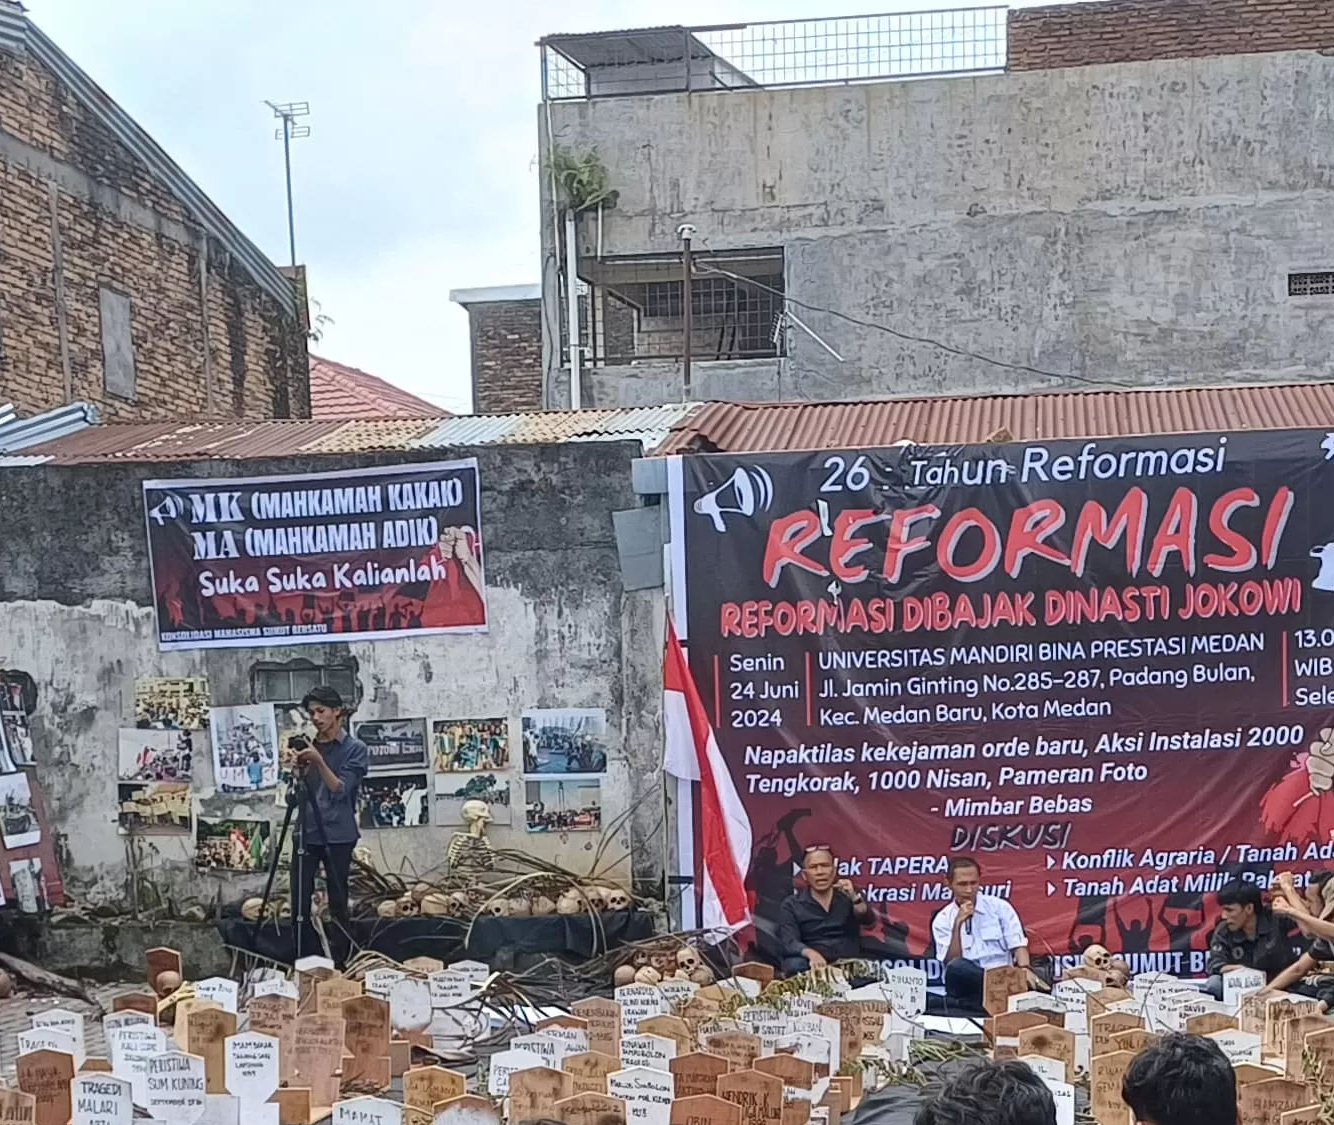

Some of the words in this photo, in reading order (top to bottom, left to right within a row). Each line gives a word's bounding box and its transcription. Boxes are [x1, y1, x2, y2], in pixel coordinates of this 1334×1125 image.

[819, 456, 870, 493] 26
[911, 457, 1006, 487] Tahun
[1021, 437, 1227, 483] Reformasi
[189, 491, 245, 524] MK
[251, 487, 382, 520] (MAHKAMAH
[387, 478, 463, 511] KAKAK)
[192, 529, 241, 560] MA
[245, 524, 376, 558] (MAHKAMAH
[382, 516, 438, 548] ADIK)
[763, 486, 1295, 588] REFORMASI
[199, 571, 259, 598] Suka
[266, 568, 326, 593] Suka
[334, 554, 447, 588] Kalianlah
[721, 597, 895, 638] REFORMASI
[903, 590, 1037, 633] DIBAJAK
[1045, 586, 1170, 626] DINASTI
[1178, 578, 1302, 620] JOKOWI
[730, 654, 784, 672] Senin
[819, 647, 945, 670] UNIVERSITAS
[950, 643, 1034, 665] MANDIRI
[1039, 640, 1086, 662] BINA
[1091, 637, 1186, 660] PRESTASI
[1191, 633, 1265, 654] MEDAN
[1295, 657, 1333, 675] WIB
[730, 684, 756, 700] 24
[759, 681, 799, 700] Juni
[819, 677, 838, 698] Jl.
[842, 677, 903, 698] Jamin
[907, 674, 978, 699] Ginting
[1109, 667, 1187, 688] Padang
[1193, 664, 1255, 685] Bulan,
[731, 709, 782, 727] 2024
[819, 708, 858, 727] Kec.
[863, 706, 931, 725] Medan
[936, 702, 987, 724] Baru,
[991, 701, 1046, 721] Kota
[1052, 698, 1111, 718] Medan
[744, 744, 855, 769] Napaktilas
[861, 740, 976, 766] kekejaman
[981, 740, 1030, 758] orde
[1036, 735, 1089, 757] baru,
[1095, 733, 1143, 754] Aksi
[1149, 728, 1242, 751] Instalasi
[1247, 725, 1304, 747] 2000
[746, 772, 860, 797] Tengkorak,
[868, 770, 920, 790] 1000
[926, 768, 992, 790] Nisan,
[999, 766, 1093, 787] Pameran
[1100, 761, 1147, 782] Foto
[945, 797, 1023, 817] Mimbar
[1029, 793, 1092, 814] Bebas
[951, 822, 1073, 852] DISKUSI
[867, 855, 949, 875] TAPERA
[1062, 849, 1133, 870] Konflik
[1139, 846, 1215, 870] Agraria
[1218, 845, 1231, 865] /
[1236, 844, 1296, 863] Tanah
[1064, 877, 1124, 897] Tanah
[1129, 875, 1178, 895] Adat
[80, 1081, 122, 1097] TRAGEDI
[78, 1099, 118, 1116] MALARI
